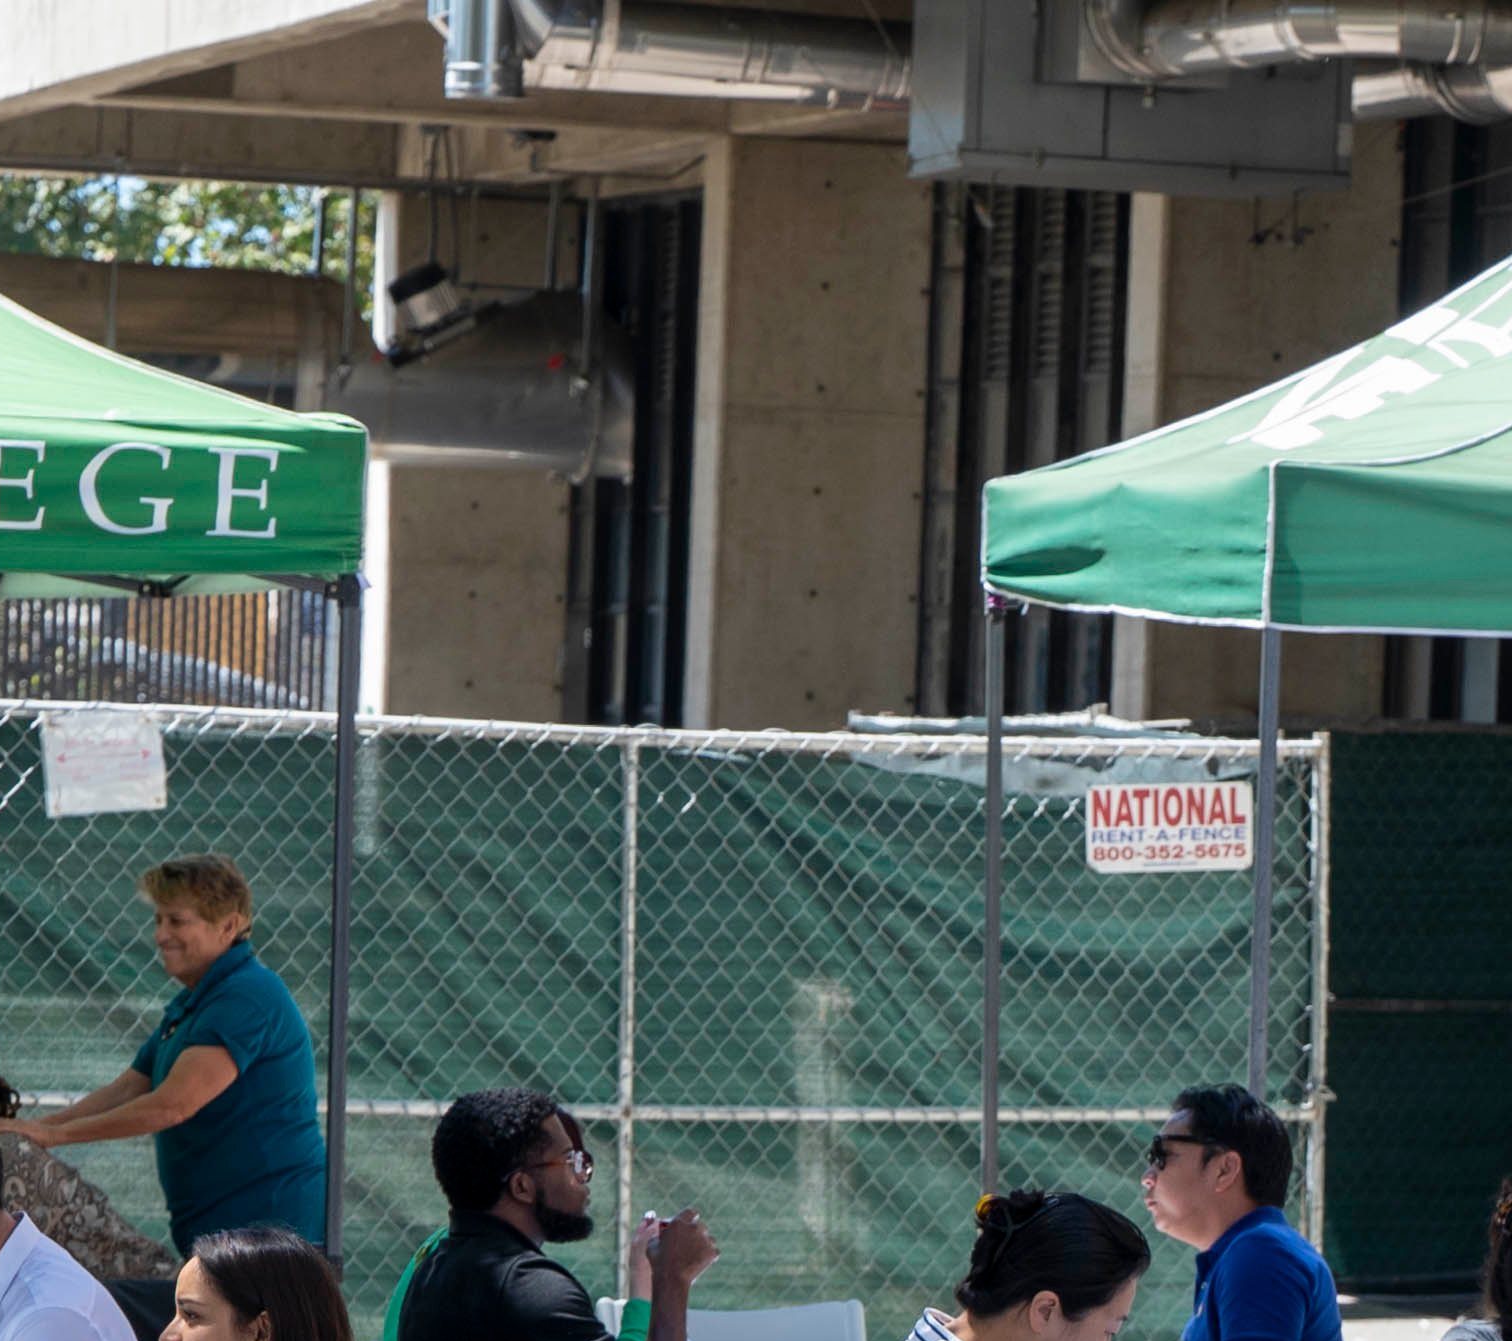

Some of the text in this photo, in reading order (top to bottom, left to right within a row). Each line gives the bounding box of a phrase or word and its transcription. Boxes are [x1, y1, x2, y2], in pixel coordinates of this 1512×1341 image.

[1091, 786, 1247, 828] NATIONAL
[1091, 827, 1248, 843] RENT-A-FENCE
[1093, 843, 1247, 861] 800-352-5675
